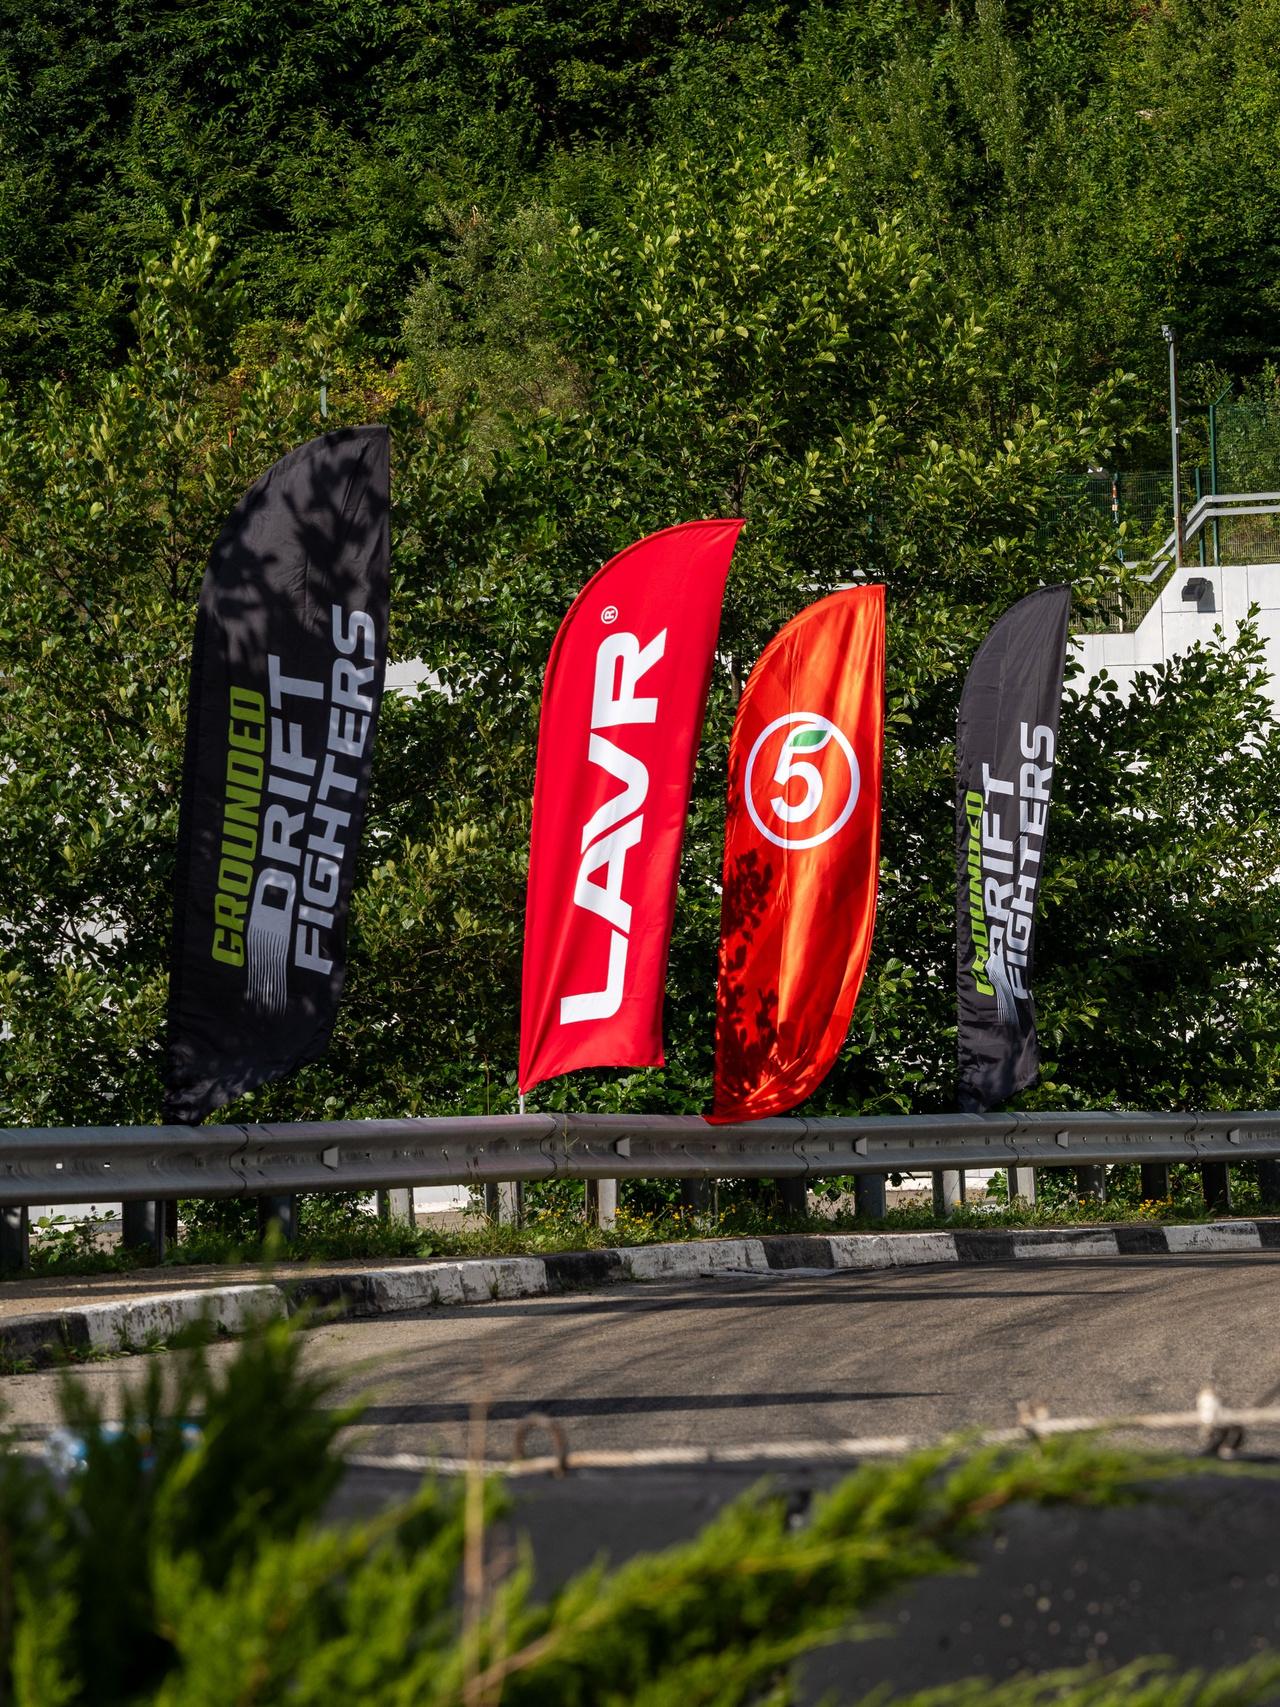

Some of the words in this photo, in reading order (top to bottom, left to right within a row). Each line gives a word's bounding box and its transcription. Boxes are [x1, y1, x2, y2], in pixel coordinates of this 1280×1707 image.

[212, 686, 266, 968] GROUNDED
[247, 654, 325, 936] DRIFT
[295, 604, 377, 976] FIGHTERS
[770, 721, 832, 823] 5
[965, 790, 995, 997] GROUNDED
[982, 762, 1015, 976] DRIFT
[1004, 721, 1055, 1000] FIGHTERS
